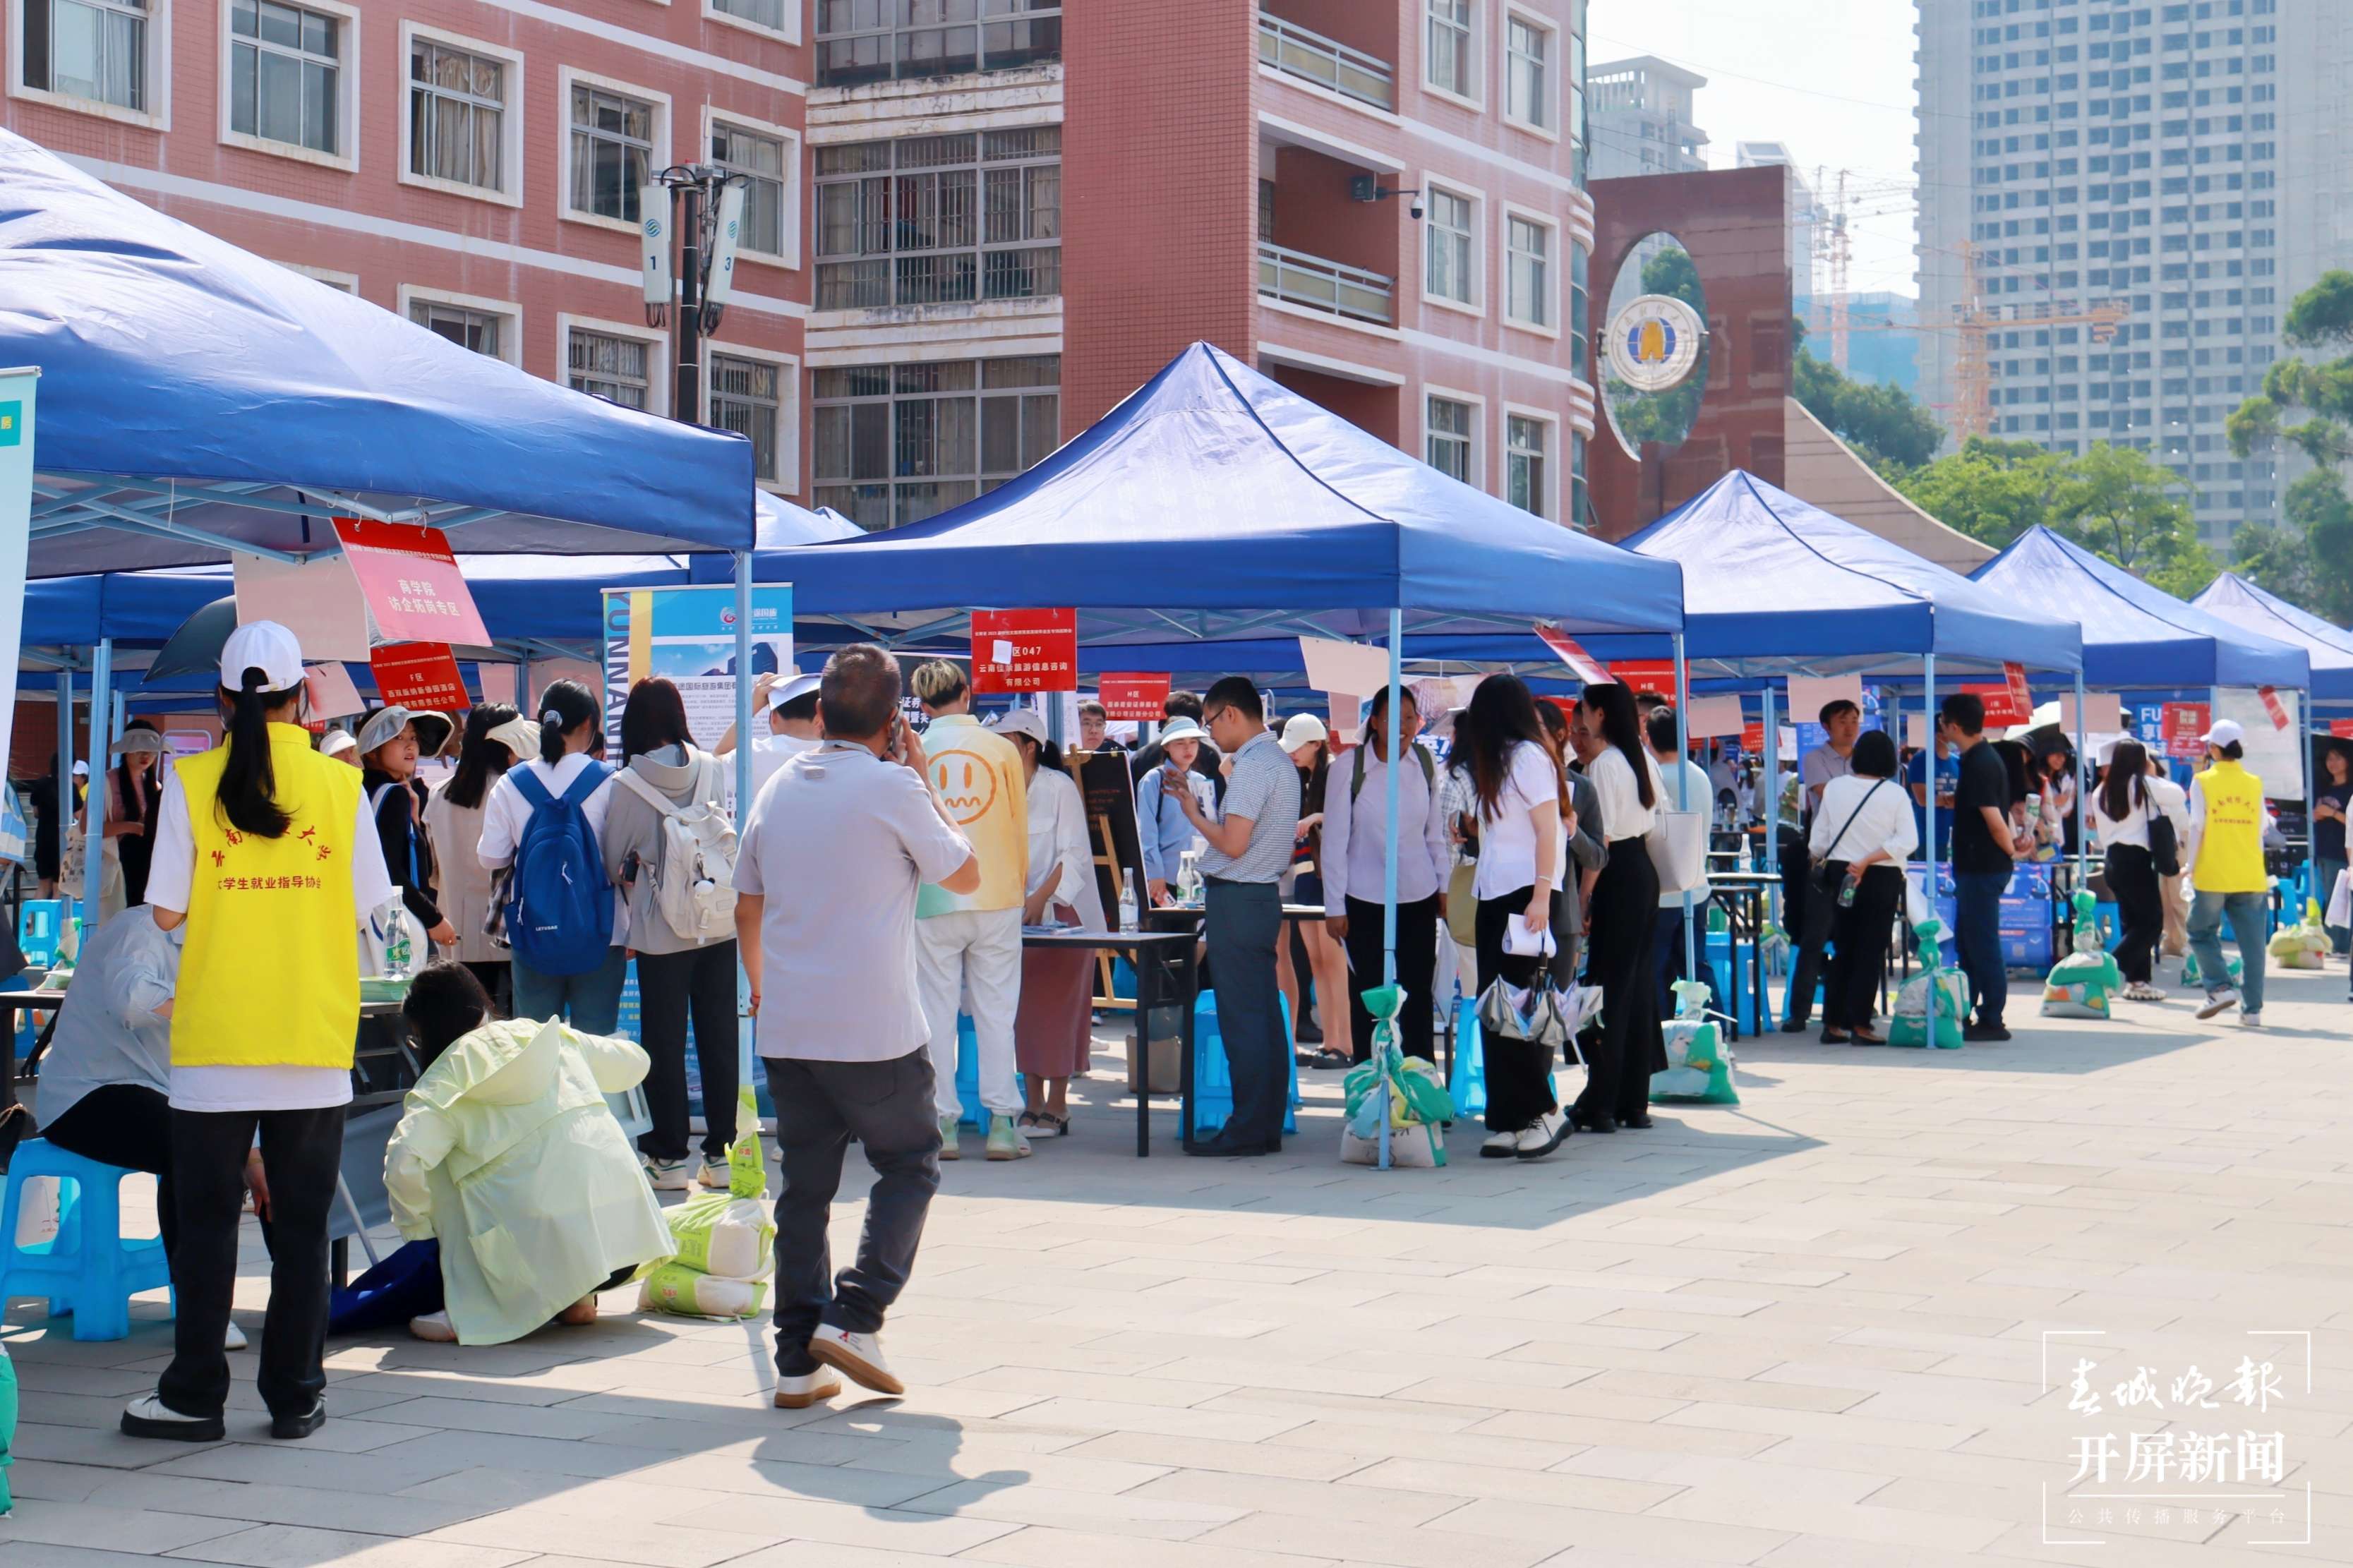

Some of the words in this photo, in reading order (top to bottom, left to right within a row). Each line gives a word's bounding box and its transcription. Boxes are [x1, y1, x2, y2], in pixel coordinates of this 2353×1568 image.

[649, 255, 656, 270] 1
[724, 256, 732, 271] 3
[397, 579, 435, 596] 商学院
[388, 596, 460, 616] 访企拓岗专区
[1005, 677, 1041, 687] 有限公司
